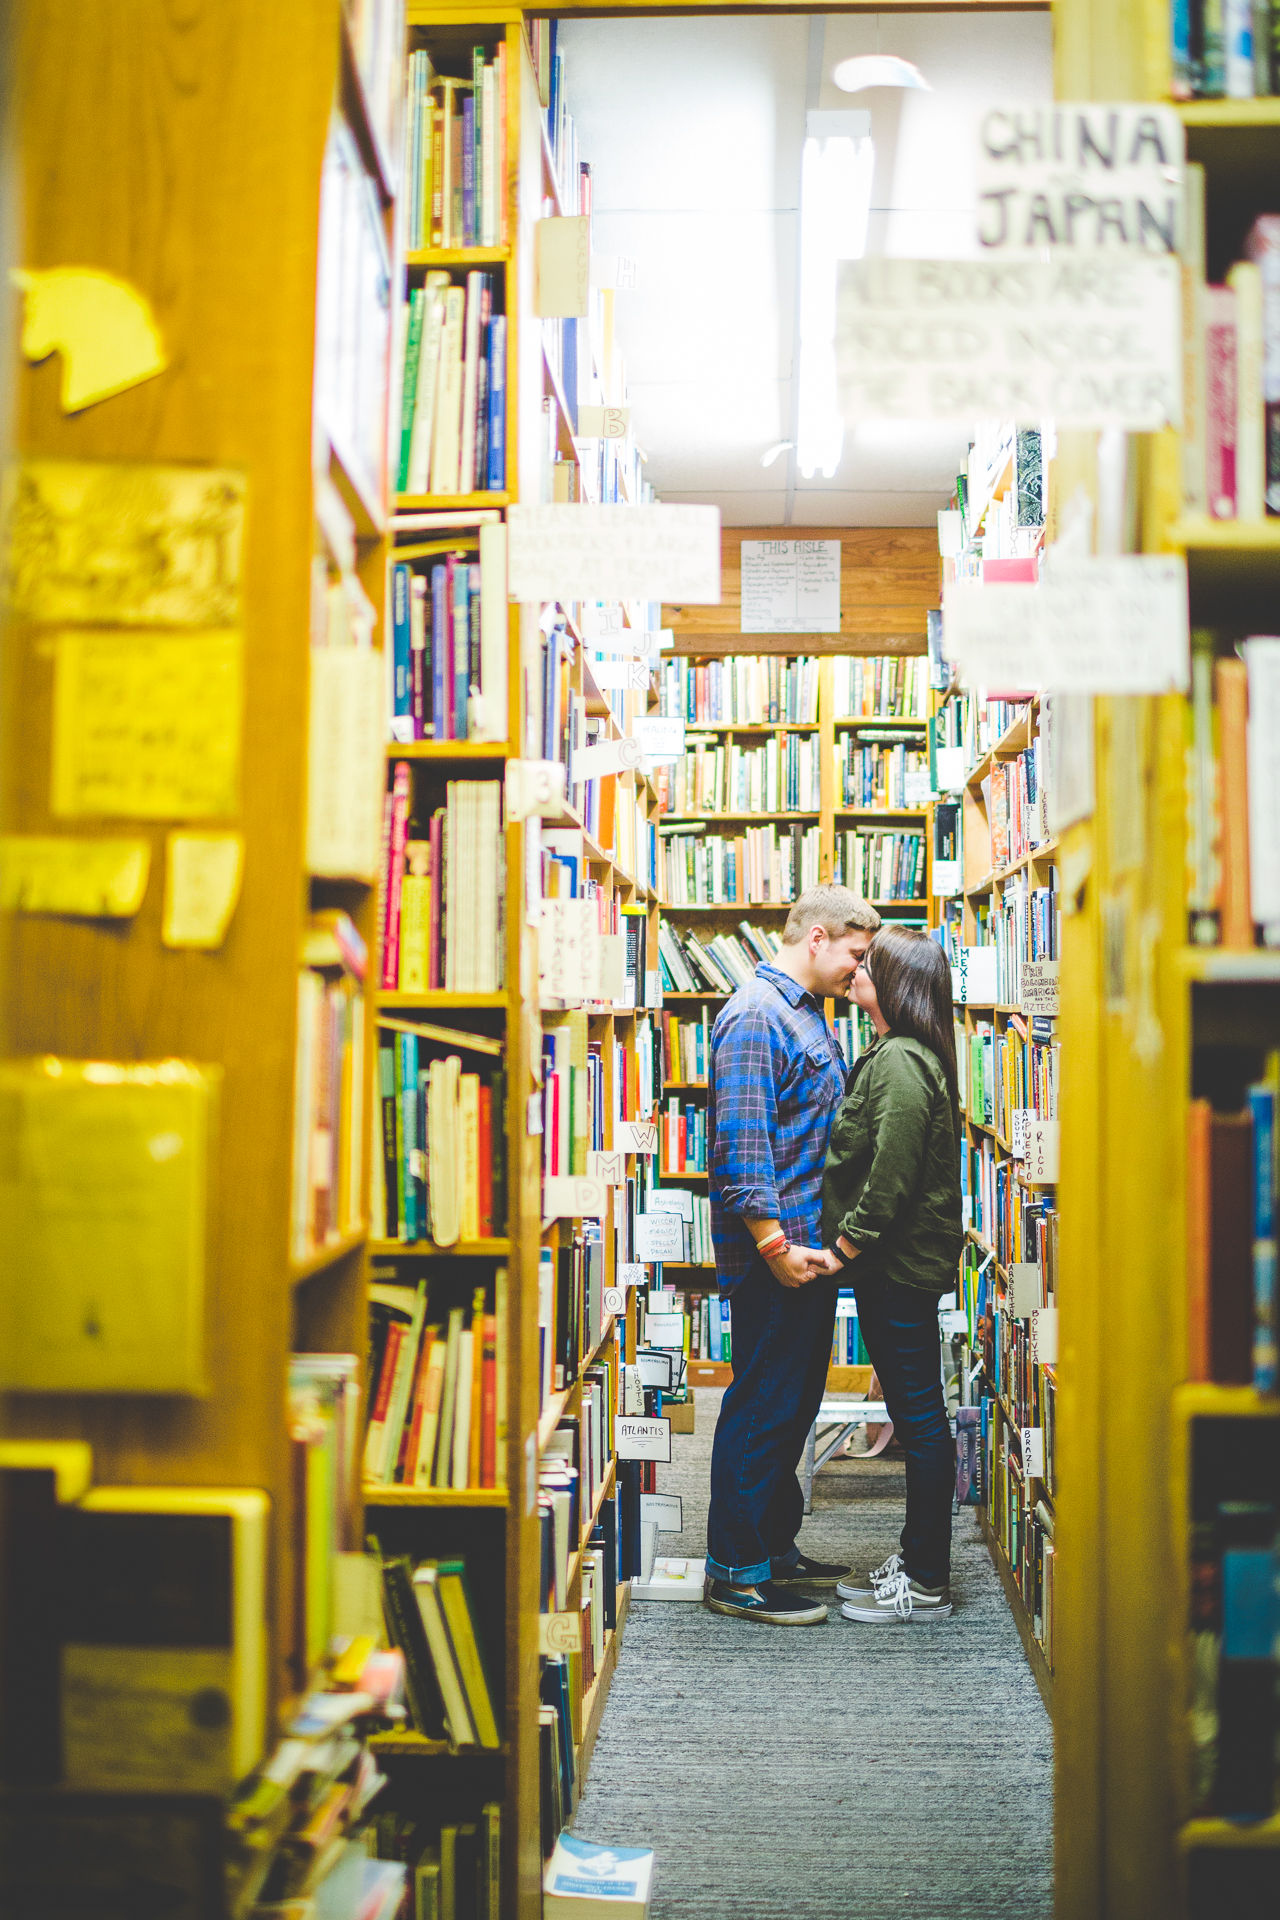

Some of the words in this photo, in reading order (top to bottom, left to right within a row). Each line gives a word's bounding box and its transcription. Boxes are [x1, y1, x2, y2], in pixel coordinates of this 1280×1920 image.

[980, 108, 1168, 168] CHINA
[978, 189, 1175, 252] JAPAN
[577, 218, 588, 314] OCCULT
[616, 256, 636, 288] H
[603, 408, 626, 438] B
[758, 541, 788, 554] THIS
[599, 609, 618, 635] I
[633, 634, 651, 655] J
[628, 664, 646, 689] K
[643, 725, 677, 734] HEALING
[619, 738, 641, 767] C
[554, 904, 564, 944] NEW
[580, 903, 592, 992] OCCULT
[551, 948, 564, 993] AGE
[960, 948, 969, 1002] MEXICO
[1023, 964, 1043, 977] PRE
[1024, 1002, 1058, 1011] AZTECS
[630, 1126, 656, 1148] W
[1025, 1122, 1033, 1180] PUERTO
[596, 1154, 621, 1184] M
[574, 1180, 601, 1212] D
[654, 1197, 685, 1210] Astrology
[623, 1274, 631, 1284] Y
[628, 1265, 639, 1275] X
[604, 1289, 623, 1312] O
[632, 1365, 642, 1406] GHOSTS
[621, 1425, 664, 1436] ATLANTIS
[1025, 1430, 1033, 1475] BRAZIL
[547, 1616, 578, 1651] G
